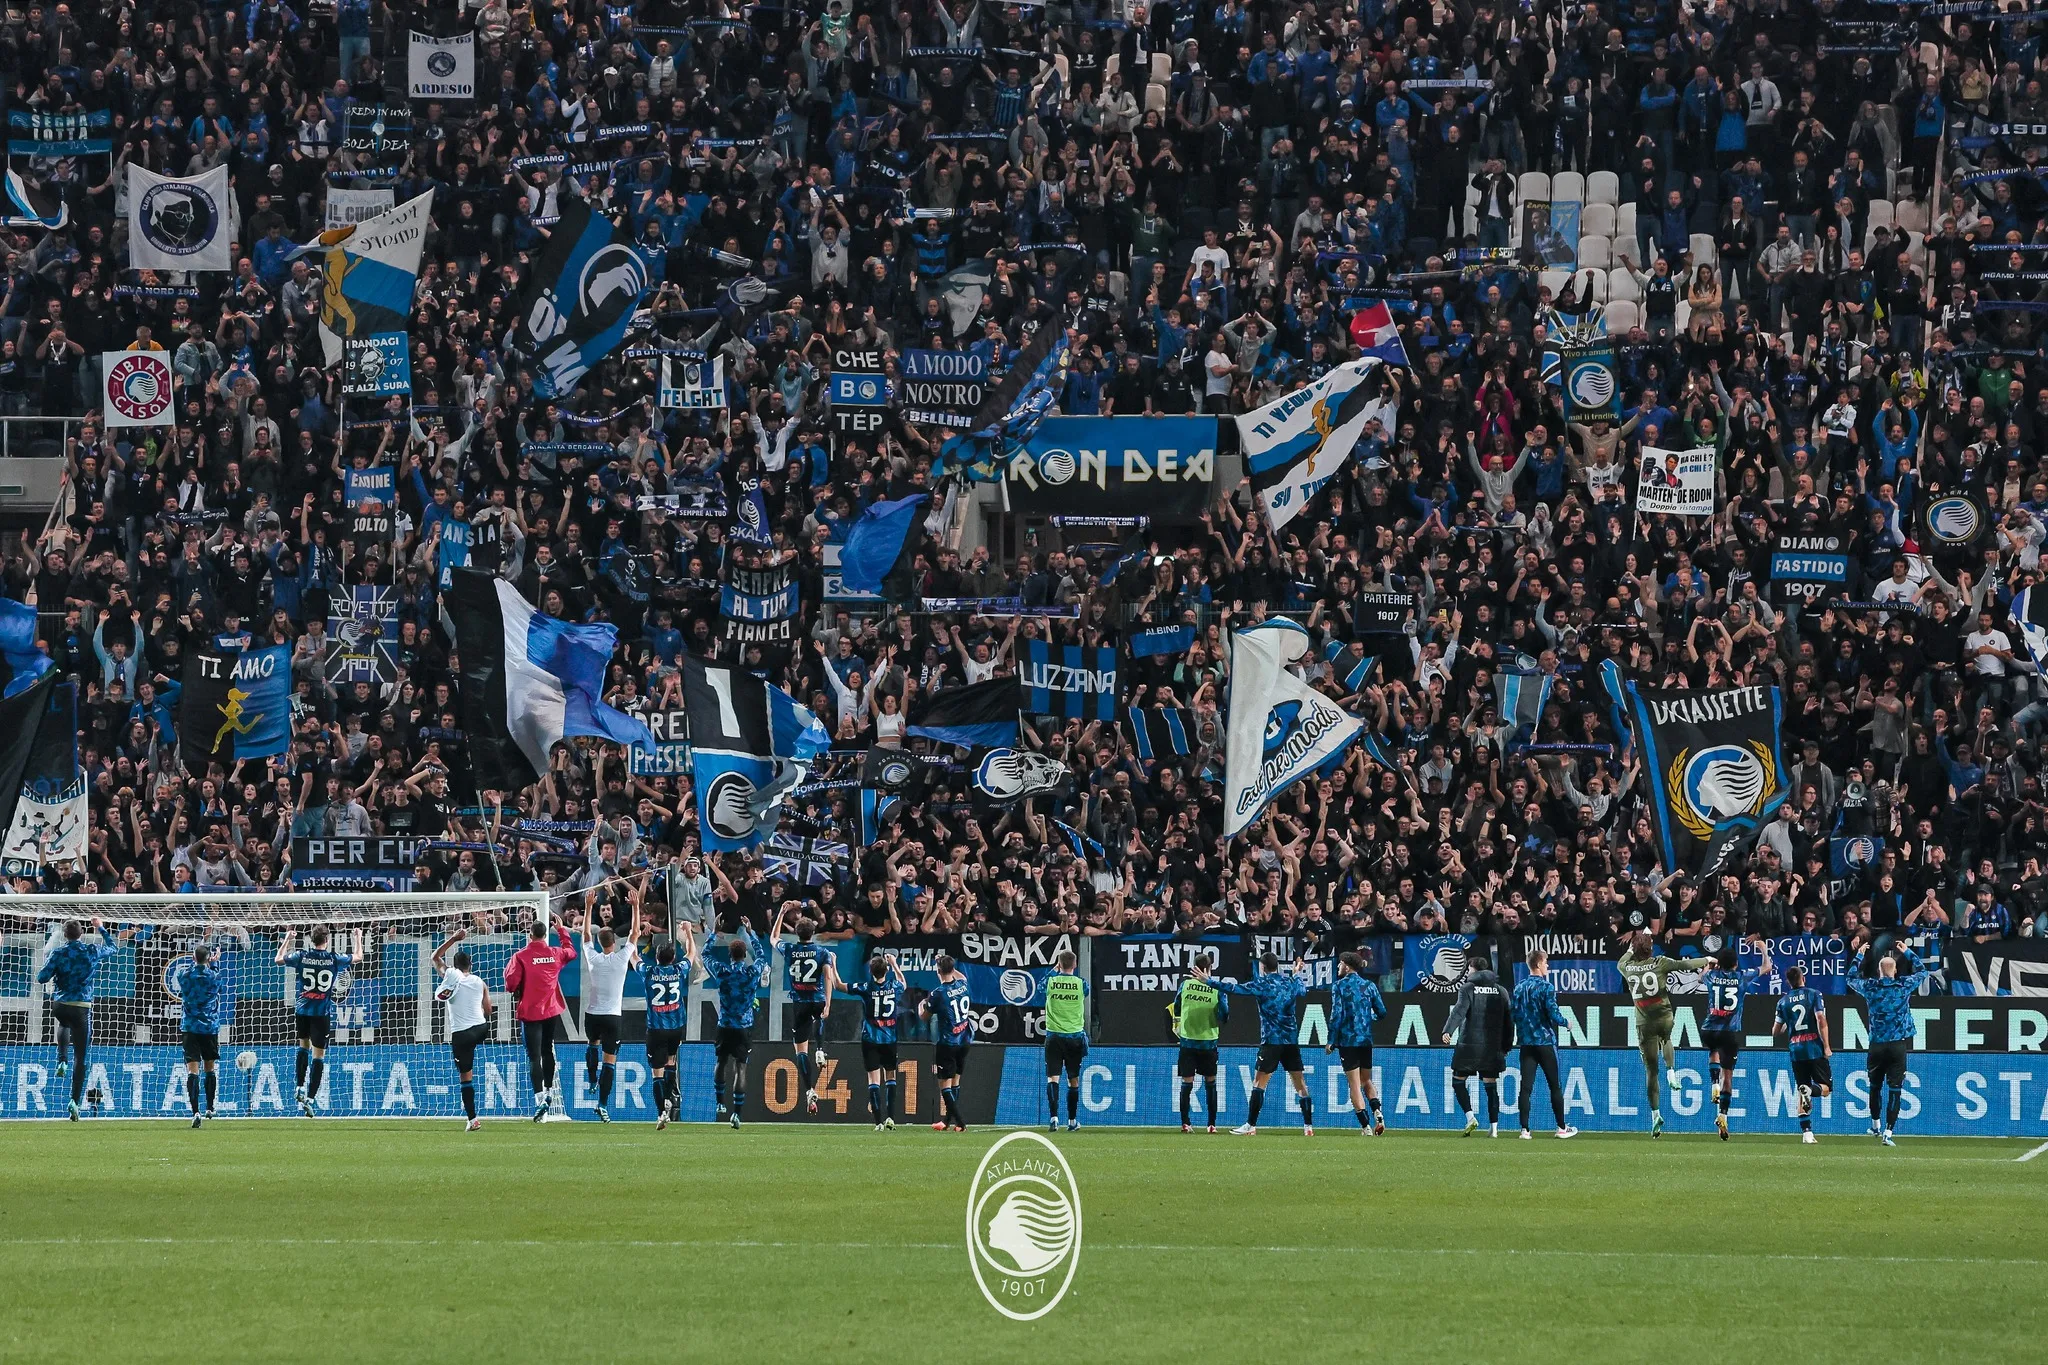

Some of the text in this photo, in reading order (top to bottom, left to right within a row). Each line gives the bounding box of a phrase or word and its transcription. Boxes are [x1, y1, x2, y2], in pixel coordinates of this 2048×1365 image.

[909, 48, 979, 57] BERGAMO
[412, 83, 472, 95] ARDESIO
[344, 106, 413, 117] CREDO IN UNA
[33, 127, 88, 140] LOTTA
[600, 124, 648, 136] BERGAMO
[343, 138, 410, 151] SOLA DEA
[517, 154, 565, 166] BERGAMO
[1556, 213, 1573, 229] 77
[145, 286, 174, 295] NORD
[345, 336, 400, 349] I RANDAGI
[836, 349, 880, 369] CHE
[1563, 350, 1580, 358] Vivo
[1588, 347, 1615, 356] amarti
[111, 357, 167, 382] UBIAL
[344, 357, 404, 370] 19 07
[906, 353, 982, 377] A MODO
[342, 384, 354, 393] DE
[383, 380, 410, 391] SURA
[904, 382, 982, 407] NOSTRO
[662, 388, 724, 408] TELGAT
[836, 410, 883, 431] TÉP
[909, 410, 972, 428] BELLINI
[1568, 413, 1583, 421] mai
[1251, 421, 1277, 439] TI
[1690, 455, 1702, 463] CHI
[1689, 464, 1702, 473] CHI
[1271, 485, 1292, 509] SU
[1688, 488, 1712, 504] ROON
[346, 500, 355, 509] 19
[679, 508, 704, 517] SEMPRE
[1649, 502, 1713, 512] Doppia ristampa
[353, 517, 388, 533] SOLTO
[443, 523, 496, 547] ANSIA
[1775, 558, 1845, 576] FASTIDIO
[731, 564, 791, 596] SEMPRE
[1784, 583, 1827, 598] 1907
[330, 598, 398, 614] ROVETTA
[733, 592, 788, 619] AL TUO
[1363, 593, 1413, 605] PARTERRE
[1376, 610, 1399, 621] 1907
[726, 619, 791, 642] FIANCO
[1145, 624, 1180, 636] ALBINO
[198, 653, 275, 680] TI AMO
[1019, 659, 1117, 695] LUZZANA
[795, 781, 825, 796] FORZA
[308, 840, 365, 864] PER
[302, 878, 376, 889] BERGAMO
[961, 932, 1073, 967] SPAKA
[1738, 937, 1845, 956] BERGAMO
[1120, 943, 1220, 971] TANTO
[789, 959, 818, 983] 42
[1797, 959, 1845, 976] BENE
[302, 969, 334, 992] 59
[1627, 971, 1659, 1000] 29
[651, 982, 681, 1006] 23
[1184, 993, 1212, 1004] ATALANTA
[1711, 985, 1739, 1011] 13
[1788, 994, 1805, 1003] TOLOI
[871, 994, 896, 1018] 15
[949, 995, 971, 1024] 19
[1791, 1004, 1809, 1032] 2
[1081, 1064, 1136, 1113] CI
[1563, 1065, 1639, 1116] AL
[1670, 1068, 1921, 1120] GEWISS
